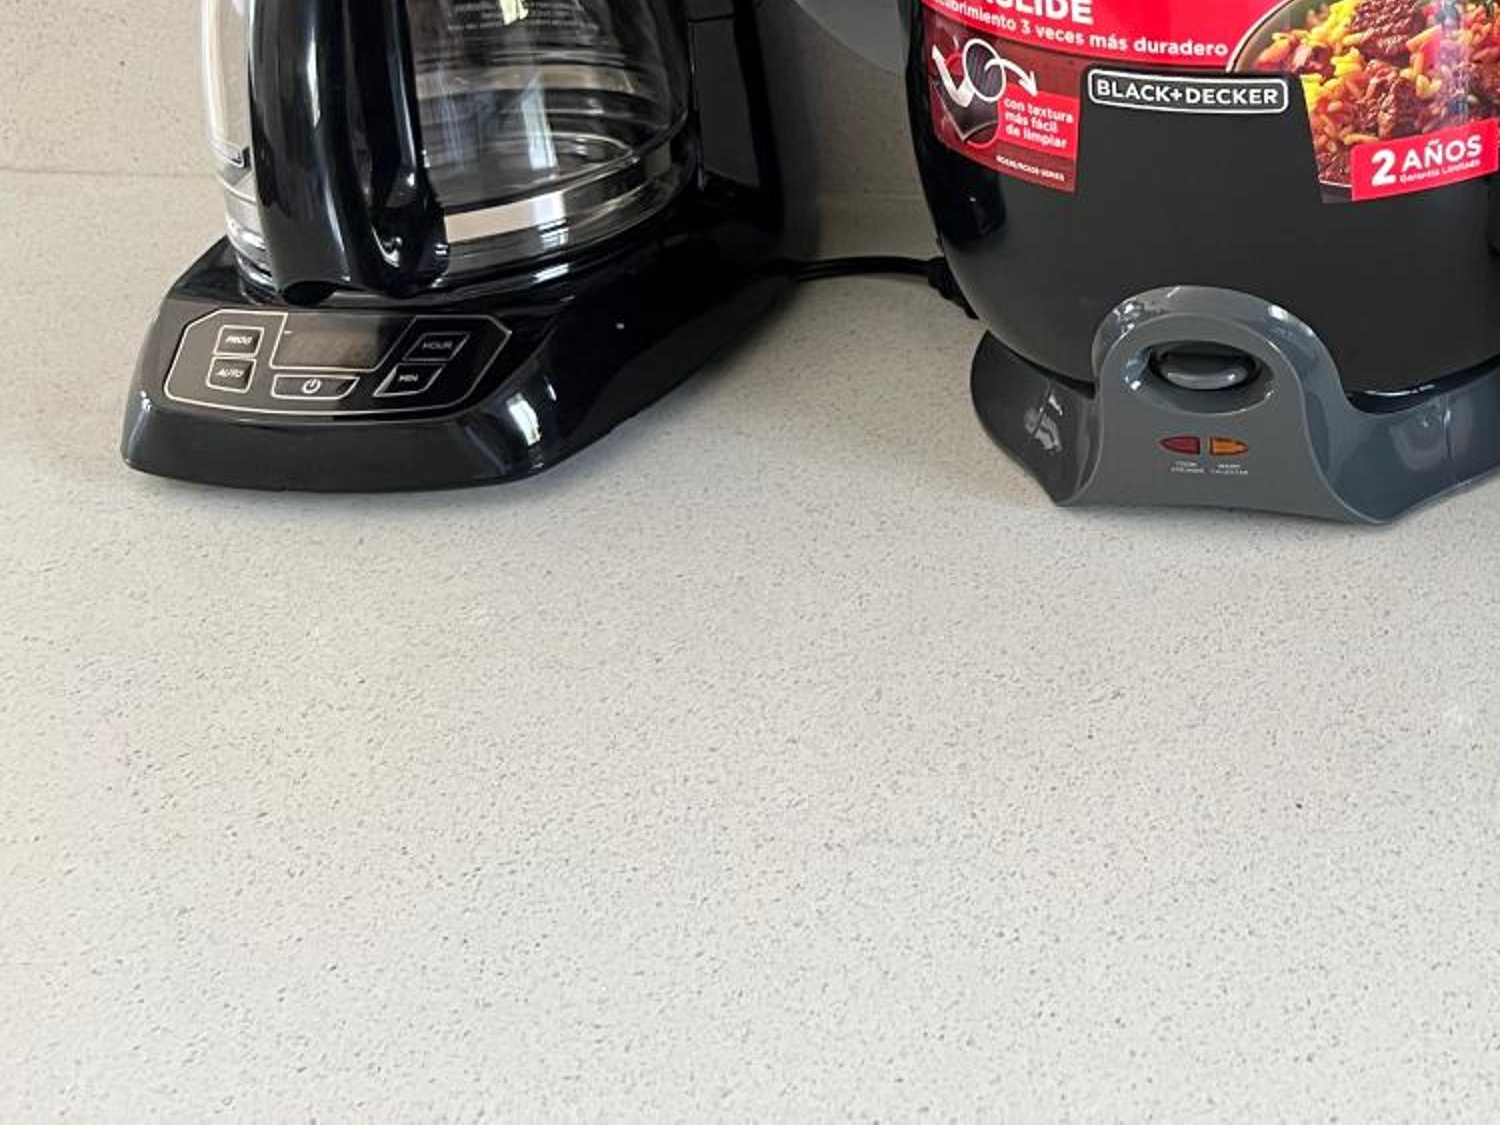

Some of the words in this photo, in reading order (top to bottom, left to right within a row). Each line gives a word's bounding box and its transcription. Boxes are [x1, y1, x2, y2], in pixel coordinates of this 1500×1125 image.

[1019, 18, 1031, 35] 3
[1035, 24, 1085, 45] veces
[1089, 33, 1127, 51] más
[1133, 36, 1229, 56] duradero
[1096, 78, 1279, 105] BLACK+DECKER
[1003, 98, 1025, 112] con
[1028, 103, 1073, 124] textura
[1005, 111, 1029, 126] más
[1005, 124, 1021, 137] de
[1023, 127, 1068, 149] limpiar
[1371, 148, 1397, 186] 2
[1401, 134, 1482, 172] AÑOS
